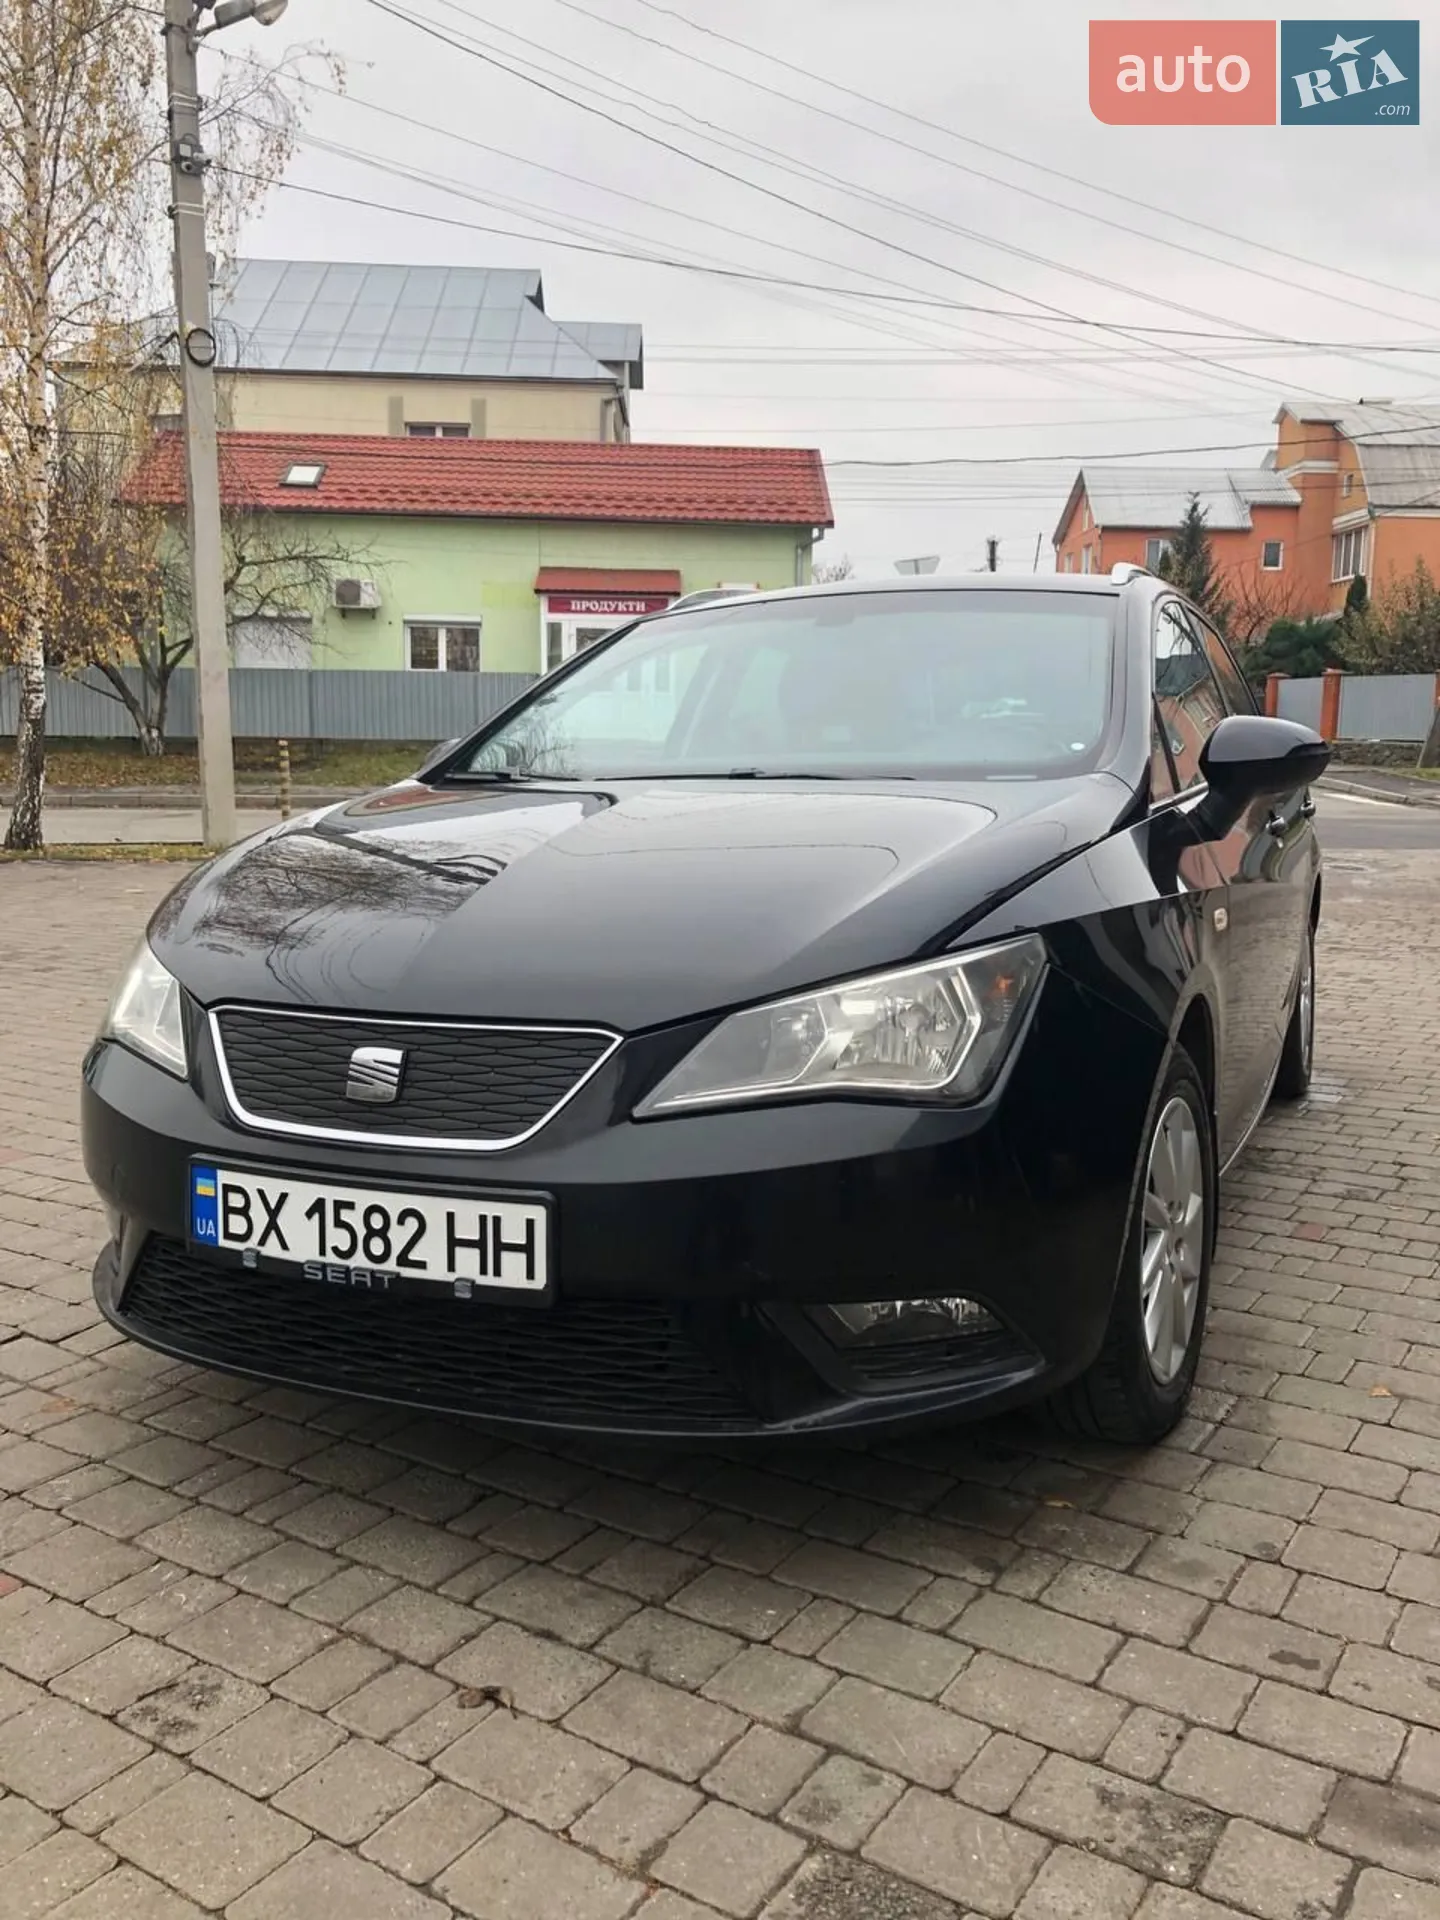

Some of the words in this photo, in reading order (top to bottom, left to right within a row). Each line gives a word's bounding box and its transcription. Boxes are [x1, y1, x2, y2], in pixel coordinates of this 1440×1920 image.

[570, 600, 646, 612] ПРОДУКТИ
[196, 1219, 217, 1238] UA
[221, 1183, 290, 1251] BX
[304, 1197, 428, 1271] 1582
[446, 1210, 536, 1281] HH
[302, 1261, 401, 1289] SEAT
